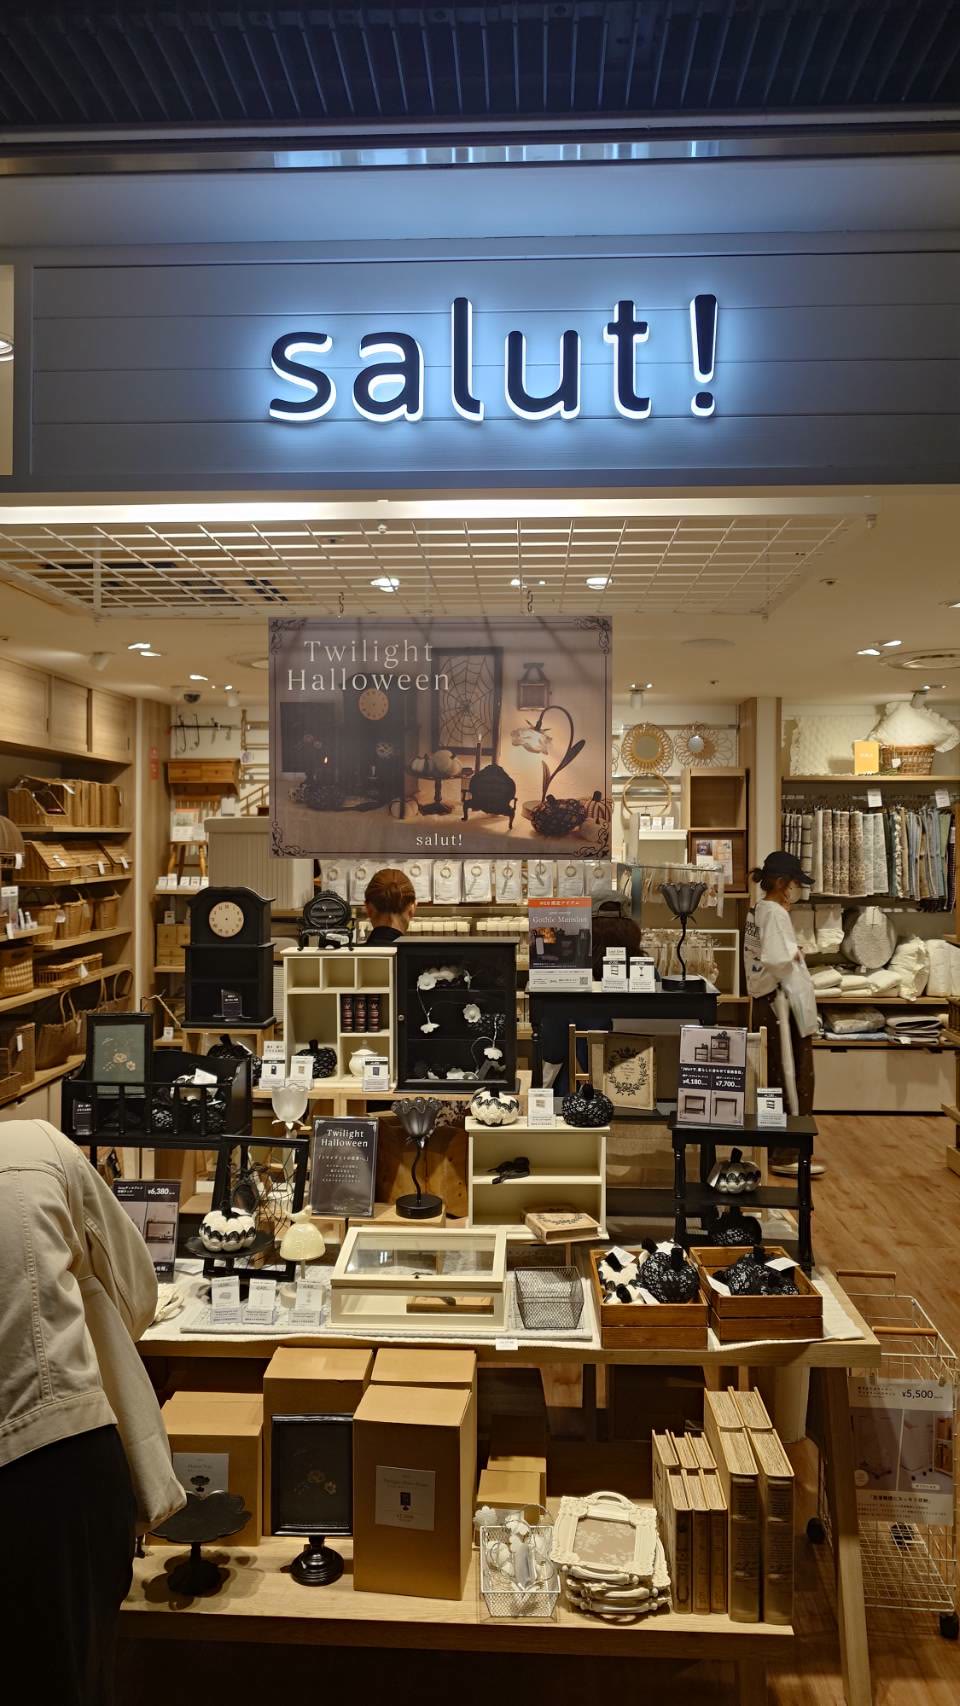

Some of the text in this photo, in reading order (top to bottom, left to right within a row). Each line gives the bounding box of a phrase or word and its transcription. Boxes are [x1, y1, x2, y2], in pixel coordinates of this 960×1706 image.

[269, 294, 717, 422] salut!
[304, 640, 433, 669] Twilight
[287, 669, 450, 691] Halloween
[415, 833, 463, 846] salut!
[715, 1080, 736, 1088] ¥7,700
[327, 1129, 364, 1140] Twilight
[320, 1138, 368, 1148] Halloween
[901, 1388, 934, 1399] ¥5,500
